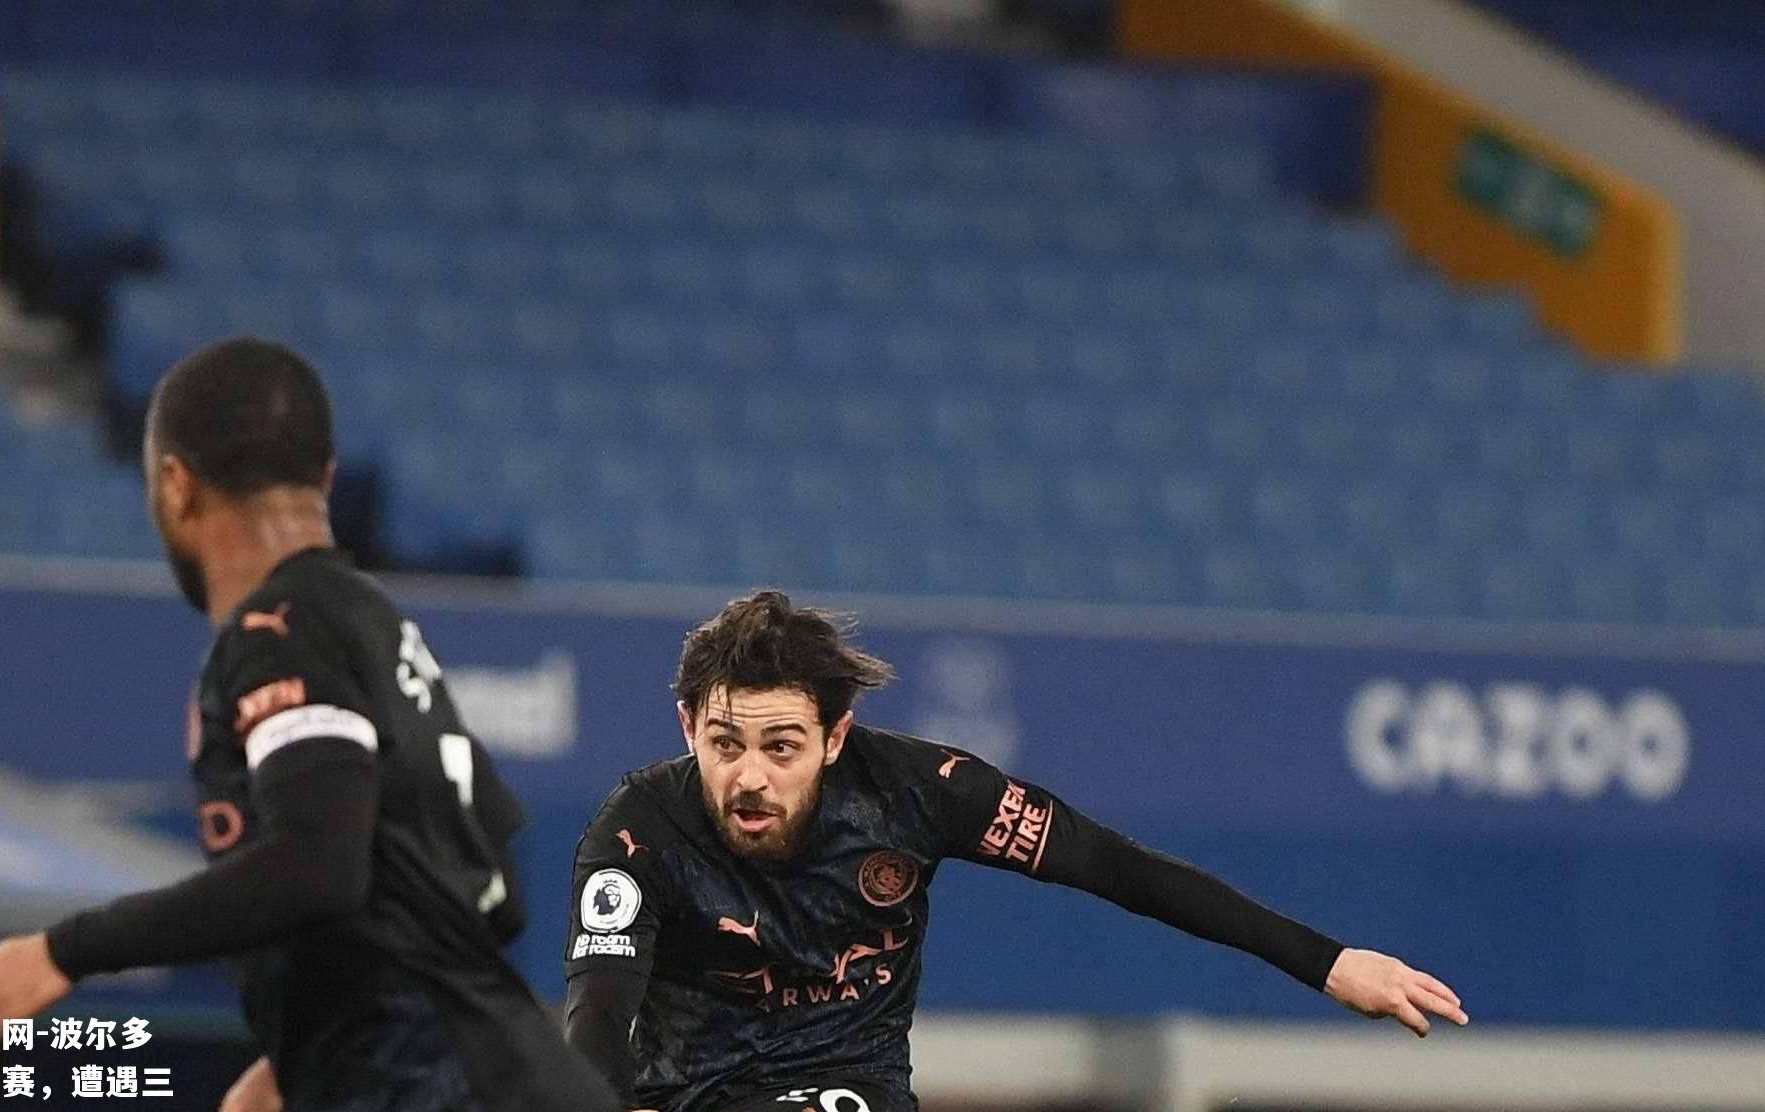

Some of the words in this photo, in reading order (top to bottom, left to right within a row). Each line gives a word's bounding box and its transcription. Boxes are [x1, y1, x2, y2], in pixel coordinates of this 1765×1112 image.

[1346, 678, 1691, 800] CAZOO
[1005, 803, 1047, 863] TIRE
[588, 944, 636, 958] racism
[591, 934, 631, 946] room
